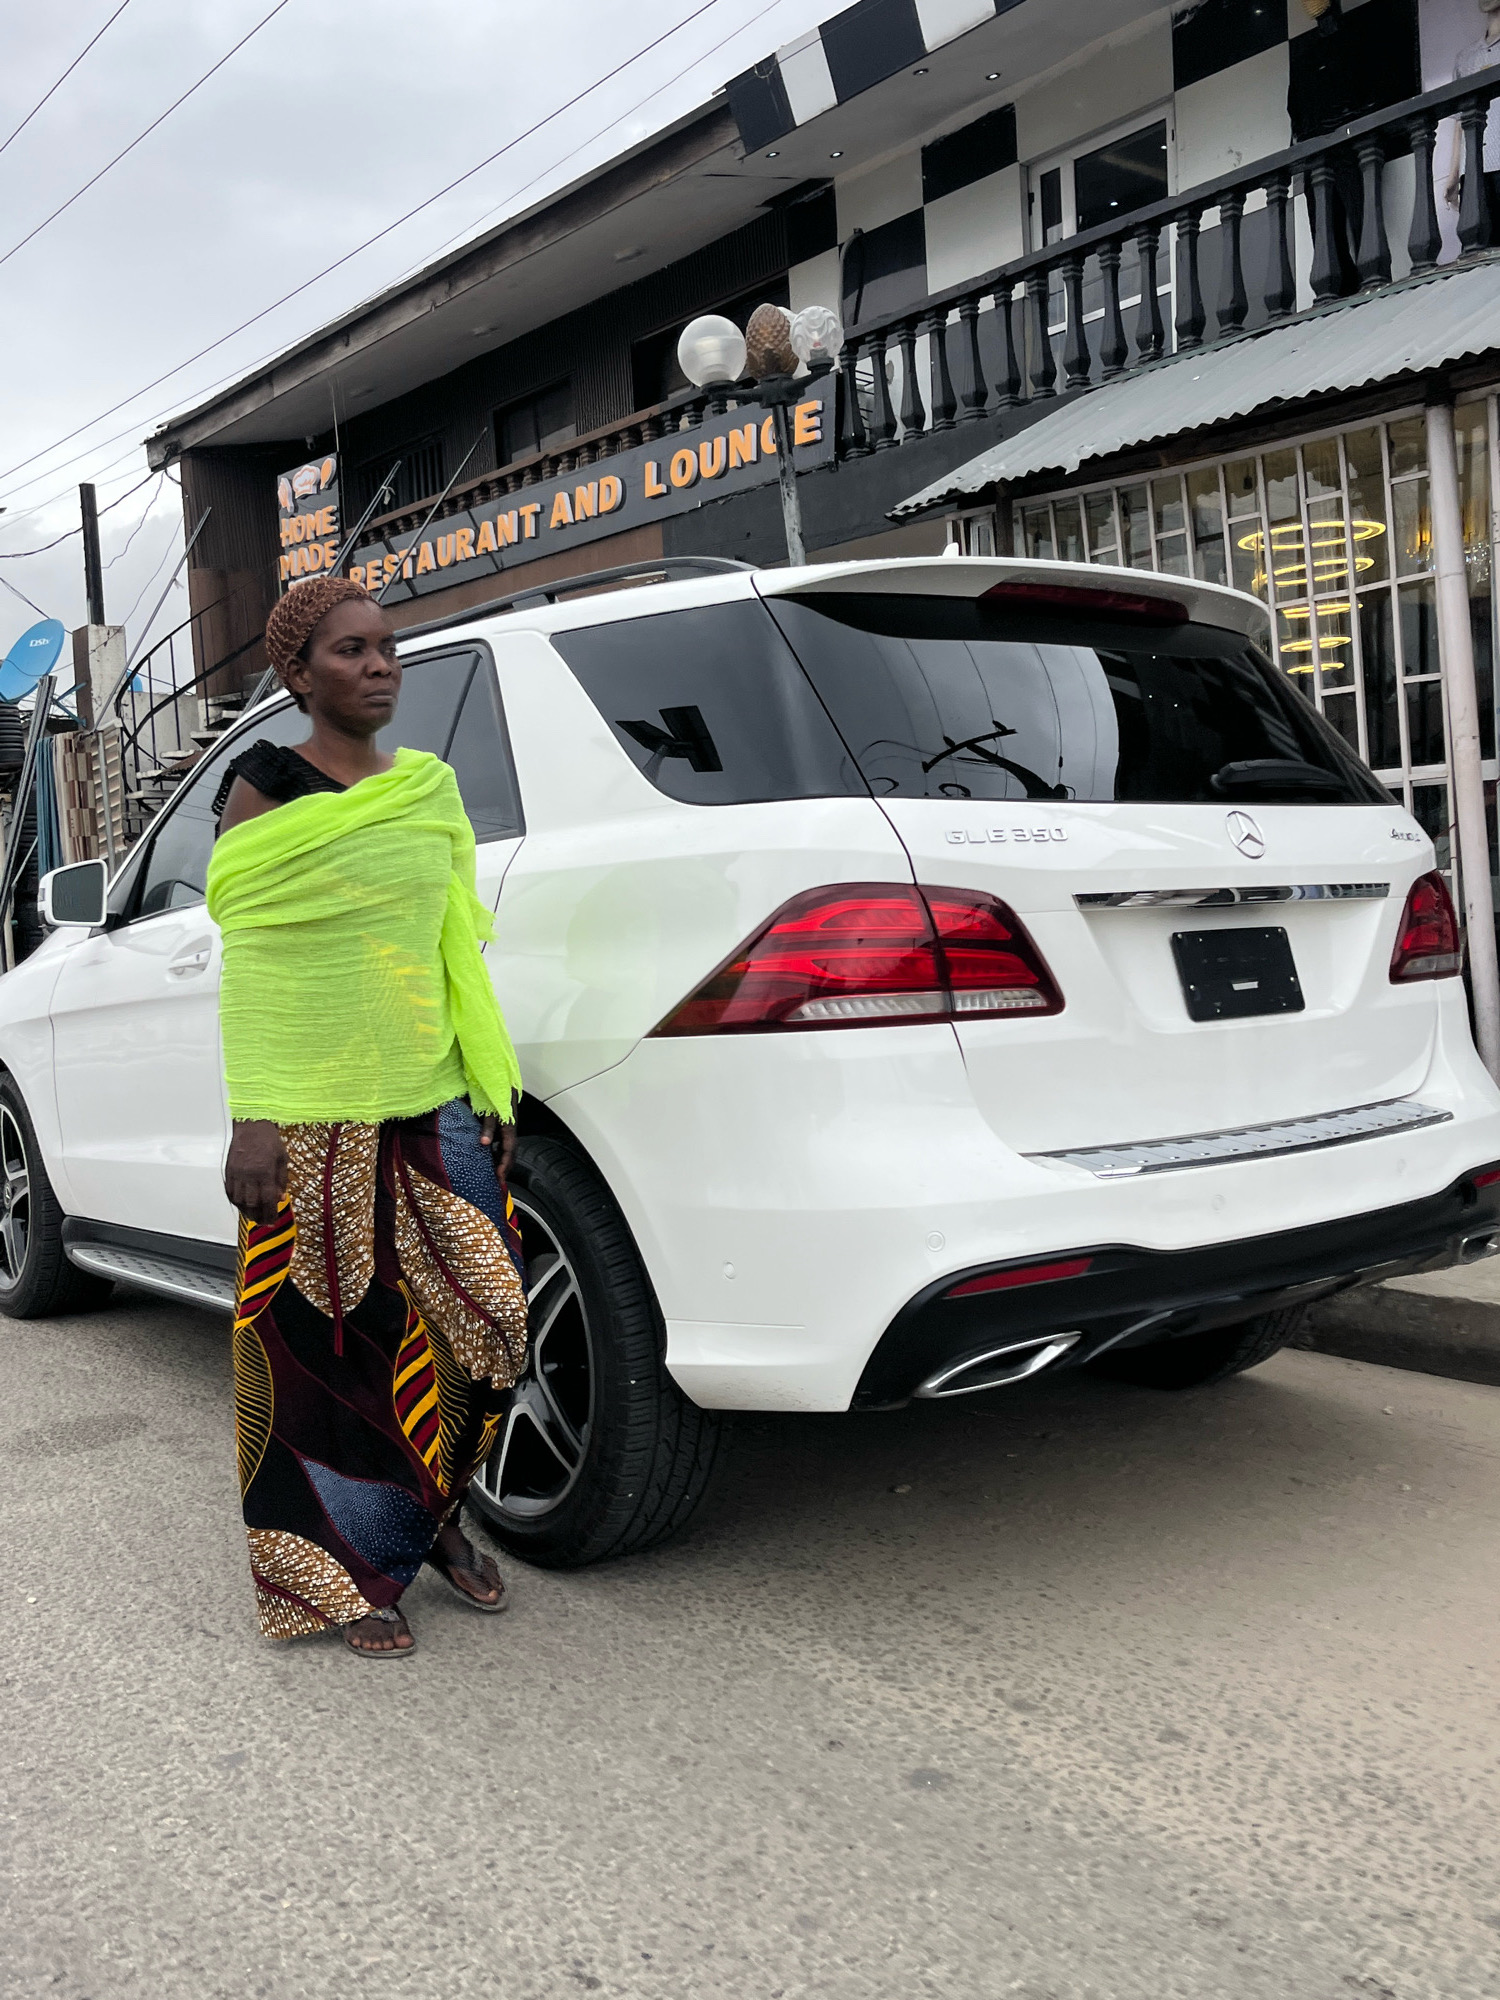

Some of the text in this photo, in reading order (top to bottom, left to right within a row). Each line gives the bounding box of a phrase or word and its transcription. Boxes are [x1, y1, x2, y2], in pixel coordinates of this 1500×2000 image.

[280, 505, 338, 548] HOME
[349, 503, 541, 592] RESTAURANT
[550, 475, 624, 529] AND
[280, 539, 339, 581] MADE
[945, 827, 1069, 845] GLE 350
